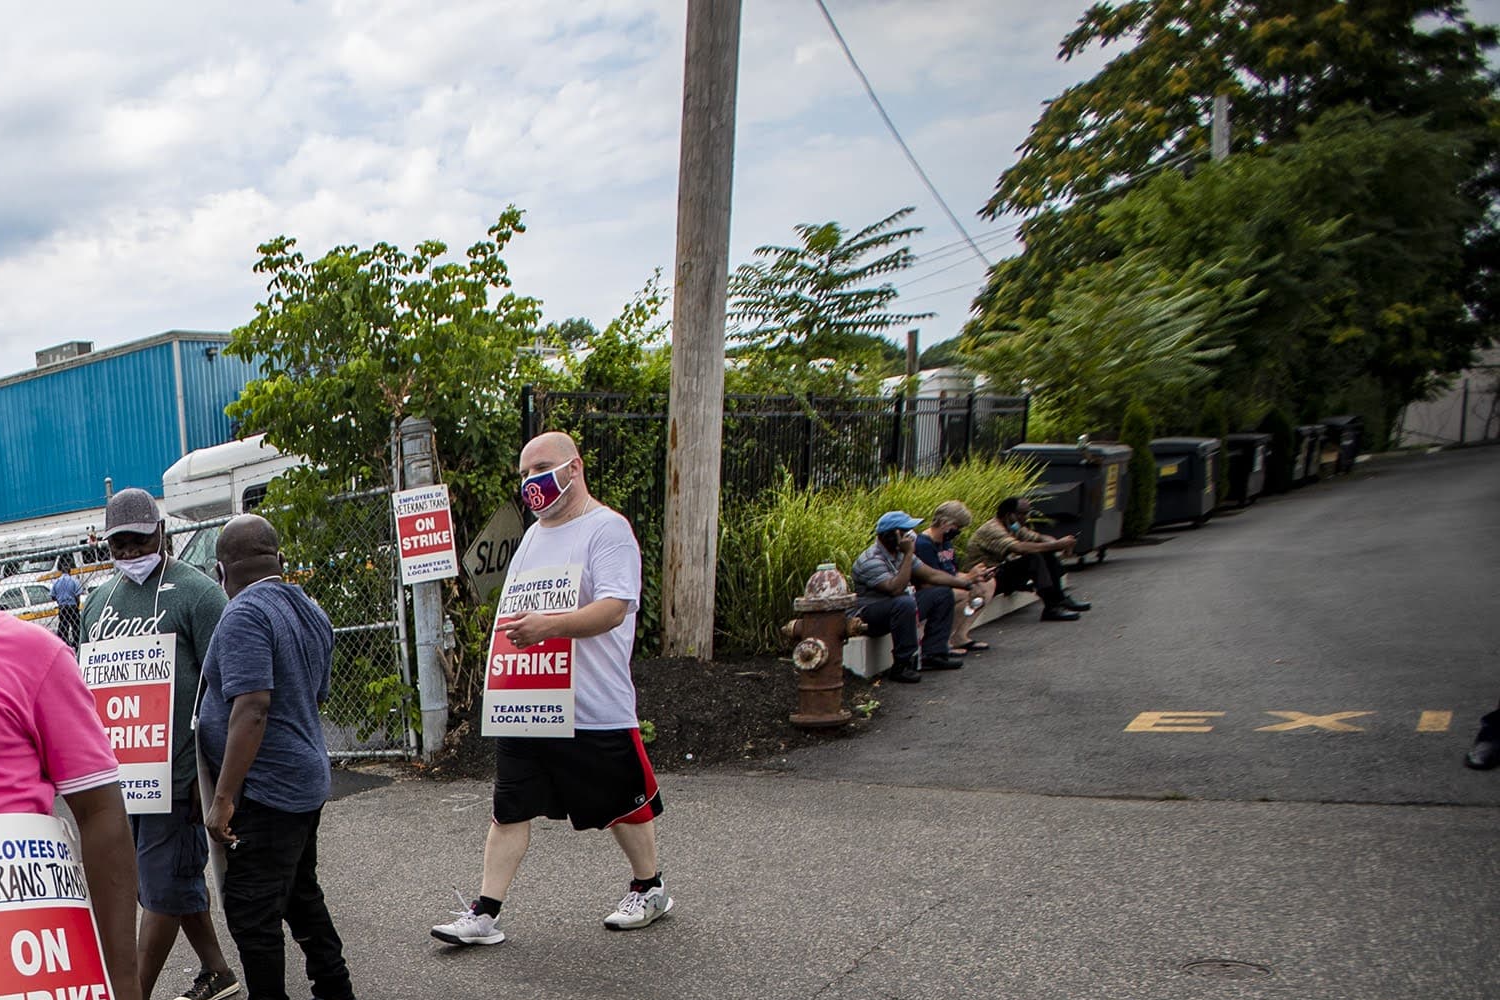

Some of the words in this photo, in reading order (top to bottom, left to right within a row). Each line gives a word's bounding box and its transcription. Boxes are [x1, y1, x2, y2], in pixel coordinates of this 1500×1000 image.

[399, 493, 434, 504] EMPLOYEES
[526, 483, 545, 510] B
[415, 516, 436, 532] ON
[402, 531, 451, 551] STRIKE
[407, 569, 430, 577] LOCAL
[408, 559, 451, 571] TEAMSTERS
[508, 579, 553, 595] EMPLOYEES
[555, 578, 571, 589] OF:
[499, 592, 541, 614] VETERANS
[542, 590, 577, 610] TRANS
[88, 605, 167, 642] Stand
[88, 649, 145, 665] EMPLOYEES
[148, 648, 165, 659] OF:
[491, 651, 569, 676] STRIKE
[133, 660, 171, 681] TRANS
[106, 695, 140, 720] ON
[493, 705, 563, 713] TEAMSTERS
[491, 715, 528, 723] LOCAL
[532, 715, 565, 724] No.25
[1123, 710, 1453, 733] EXI
[103, 723, 166, 750] RIKE
[120, 779, 160, 789] STERS
[126, 791, 162, 800] No.25
[57, 842, 73, 861] OF:
[46, 862, 87, 899] TRANS
[10, 928, 71, 976] ON
